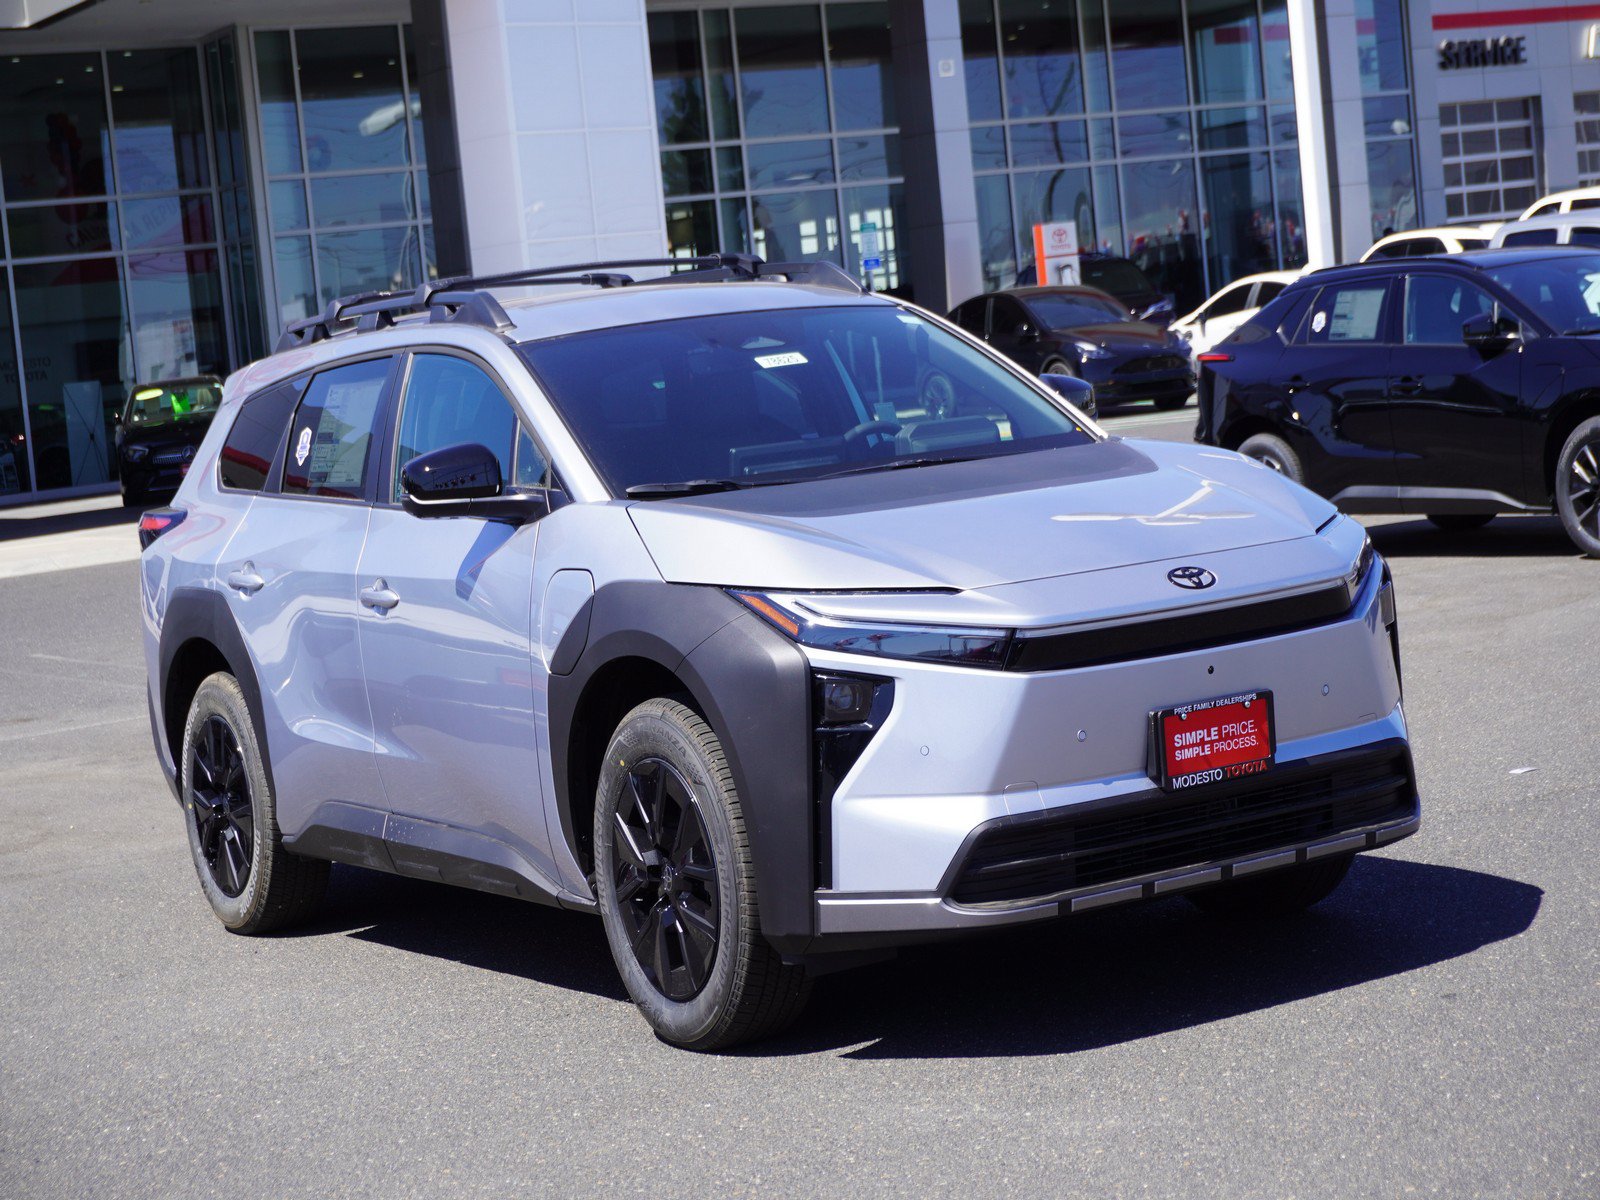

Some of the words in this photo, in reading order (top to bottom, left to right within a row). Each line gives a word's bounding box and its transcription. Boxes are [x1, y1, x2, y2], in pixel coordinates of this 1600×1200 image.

[1438, 35, 1527, 70] SERVICE
[1173, 705, 1192, 715] PRICE
[1193, 700, 1215, 712] FAMILY
[1215, 693, 1257, 707] DEALERSHIPS
[1174, 727, 1219, 747] SIMPLE
[1221, 719, 1258, 738] PRICE.
[1174, 744, 1212, 761] SIMPLE
[1213, 735, 1259, 753] PROCESS.
[1172, 768, 1223, 789] MODESTO
[1225, 760, 1268, 778] TOYOTA
